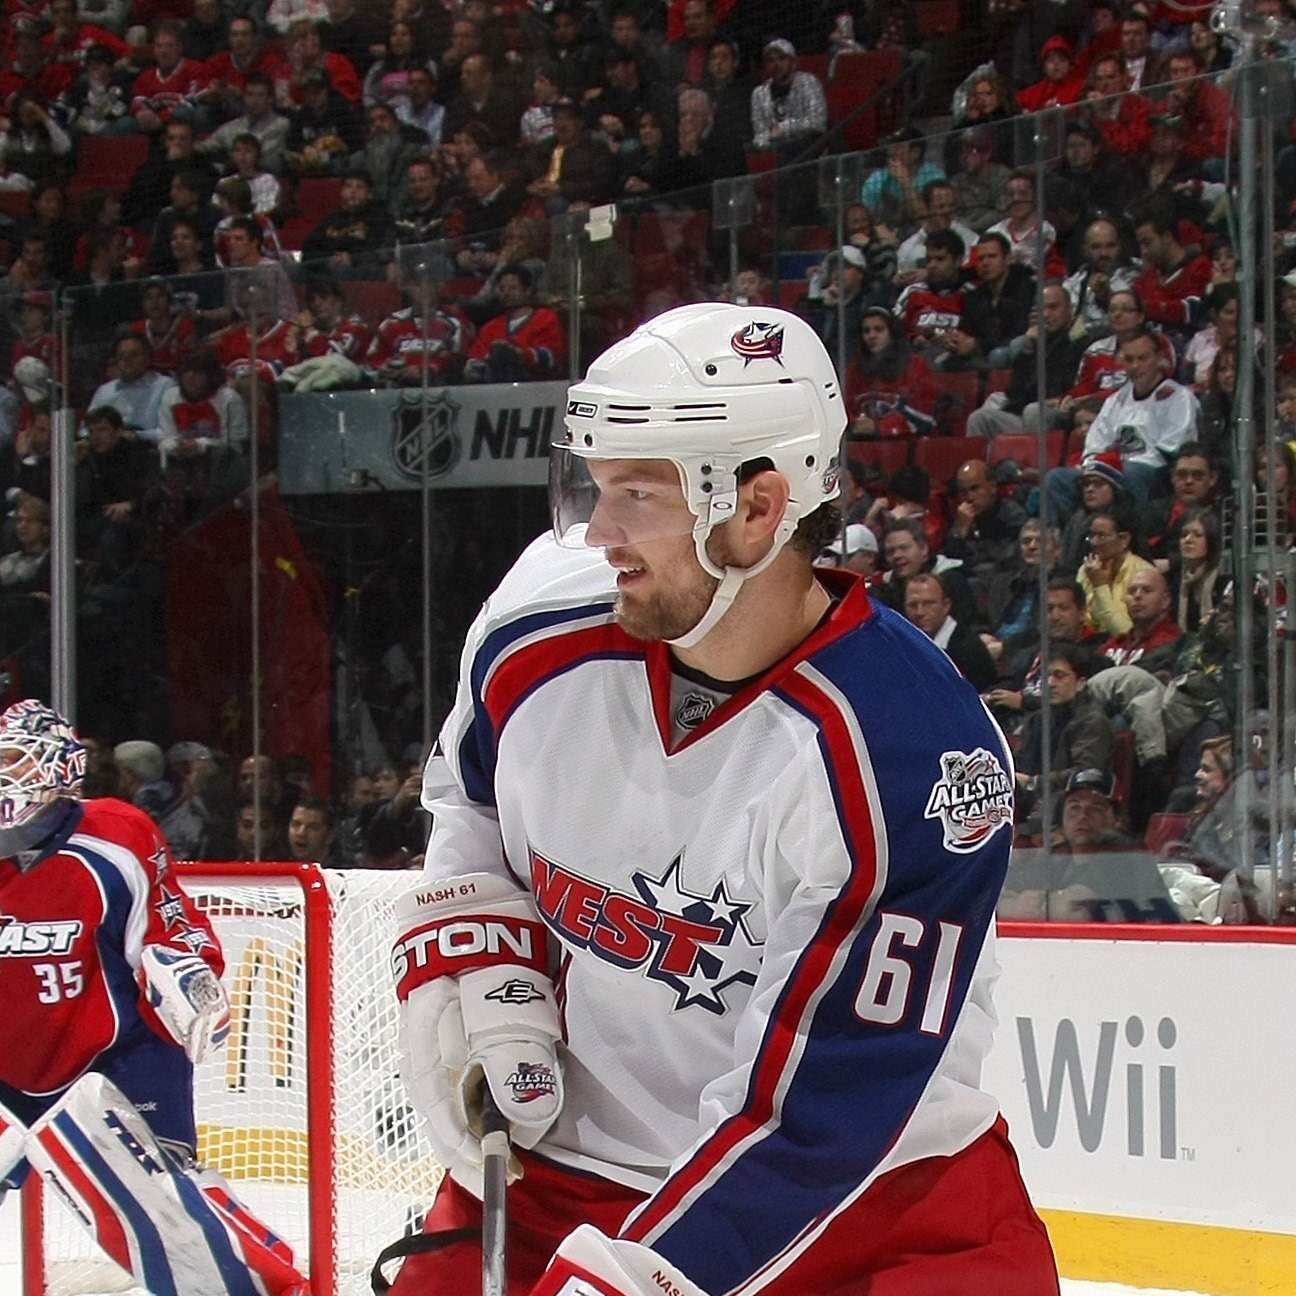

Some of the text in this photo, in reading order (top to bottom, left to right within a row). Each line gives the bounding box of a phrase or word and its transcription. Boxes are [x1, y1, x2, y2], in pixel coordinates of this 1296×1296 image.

[416, 884, 476, 906] NASH 61
[532, 855, 724, 976] WEST
[33, 960, 83, 1004] 35
[855, 912, 963, 1035] 61
[1016, 1015, 1177, 1160] Wii
